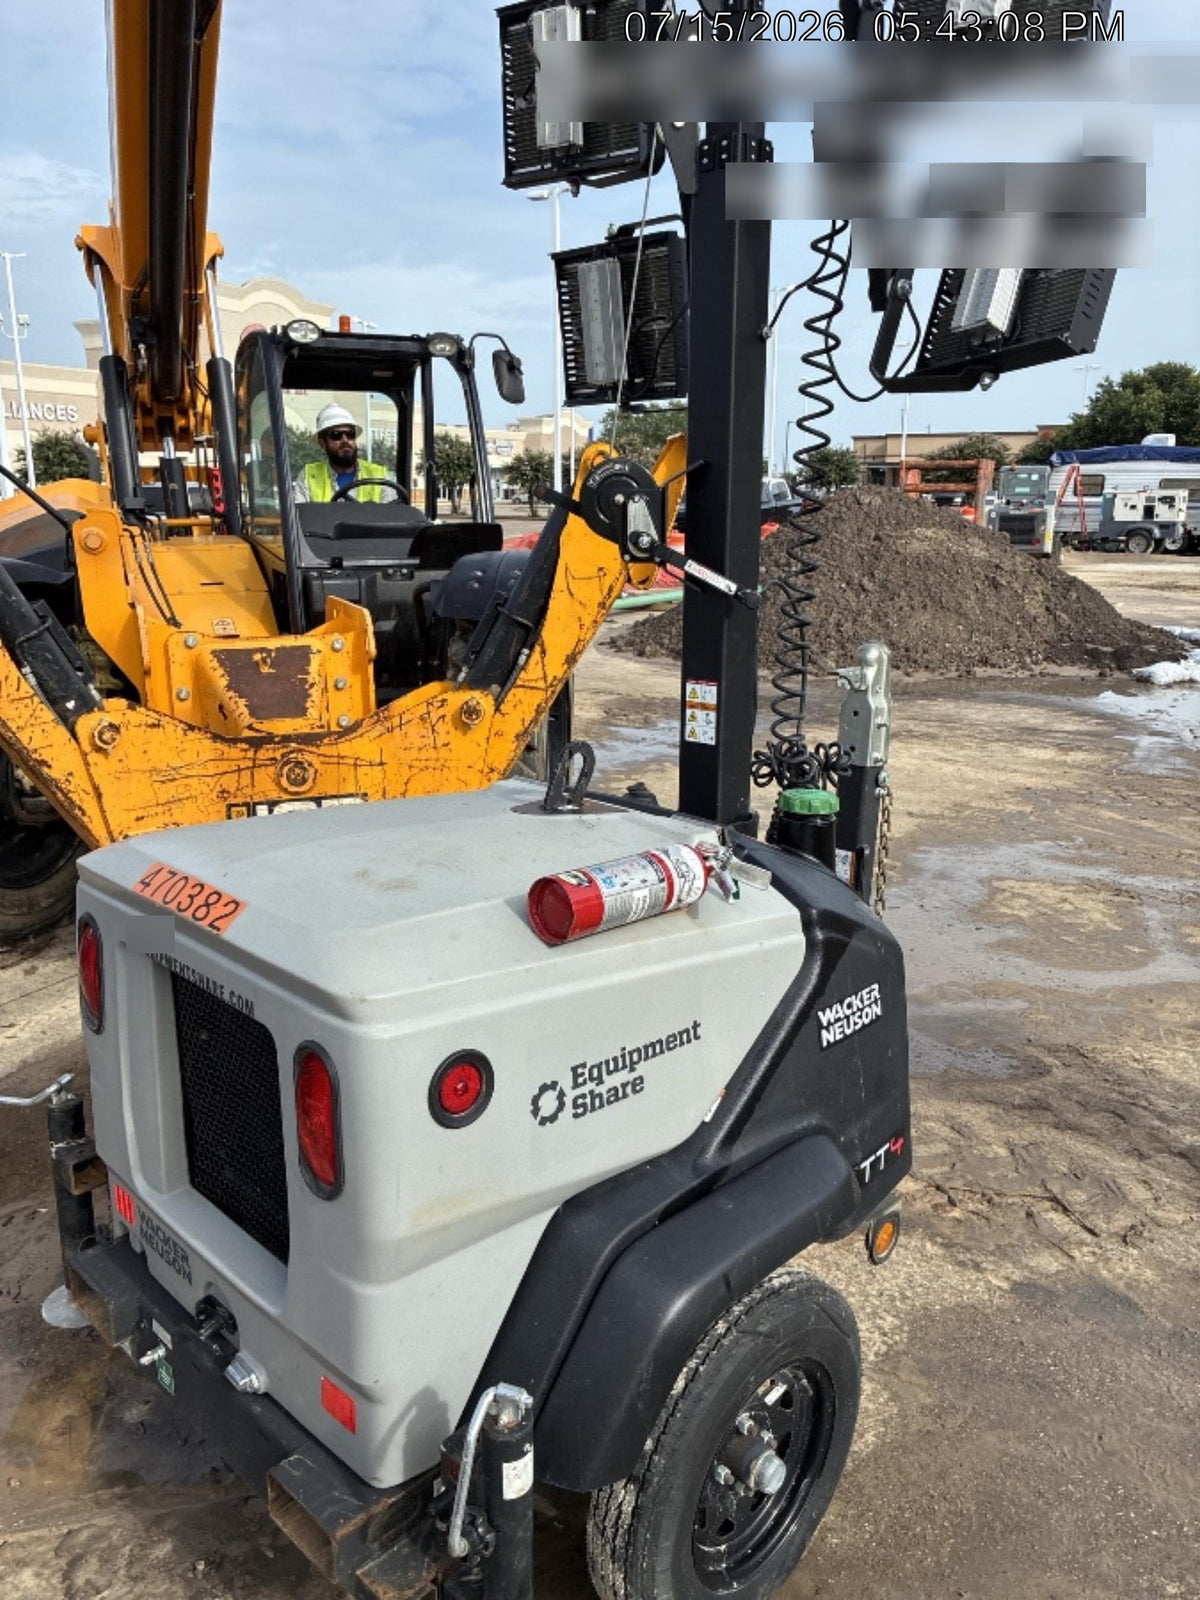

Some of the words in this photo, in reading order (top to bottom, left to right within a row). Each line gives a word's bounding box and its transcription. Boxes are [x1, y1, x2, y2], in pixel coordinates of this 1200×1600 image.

[139, 866, 241, 932] 470382
[817, 982, 881, 1027] WACKER
[820, 998, 882, 1048] NEUSON
[570, 1020, 701, 1091] Equipment
[571, 1075, 644, 1119] Share
[860, 1136, 904, 1183] TT4
[137, 1205, 190, 1268] WACKER
[140, 1224, 192, 1286] NEUSON
